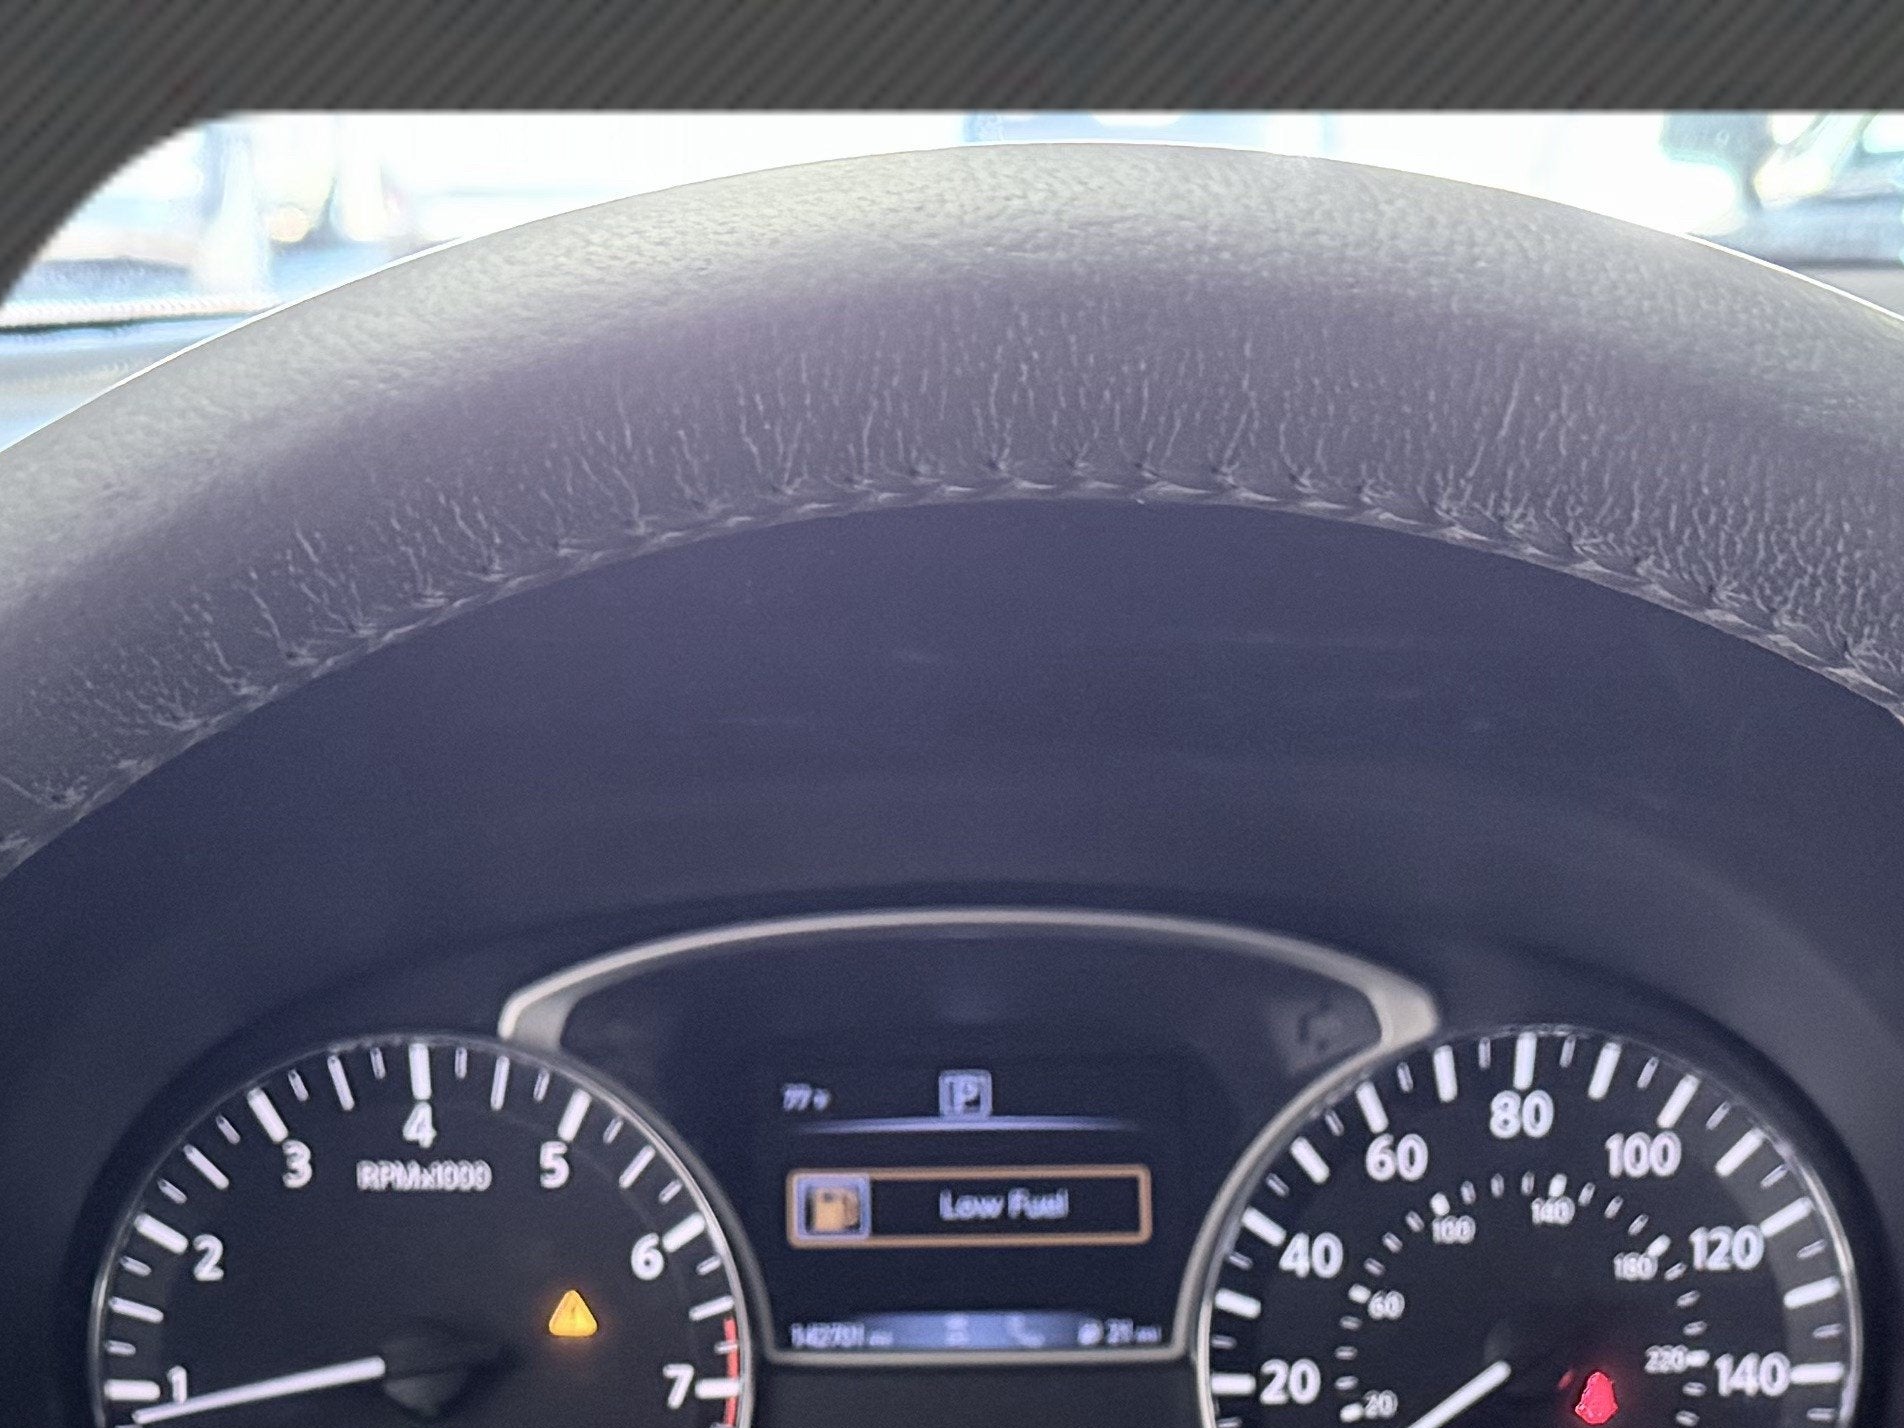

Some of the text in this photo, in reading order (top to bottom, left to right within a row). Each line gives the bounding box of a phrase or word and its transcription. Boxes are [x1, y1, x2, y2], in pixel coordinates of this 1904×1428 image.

[404, 1101, 437, 1149] 4
[1489, 1089, 1555, 1138] 80
[284, 1141, 314, 1189] 3
[539, 1141, 570, 1190] 5
[1364, 1133, 1430, 1182] 60
[1605, 1130, 1683, 1179] 100
[939, 1186, 1070, 1221] Low Fuel
[1530, 1195, 1576, 1227] 140
[1431, 1214, 1477, 1246] 100
[1688, 1225, 1766, 1271] 120
[192, 1237, 225, 1282] 2
[630, 1233, 666, 1281] 6
[1279, 1231, 1344, 1278] 40
[1613, 1252, 1658, 1283] 180
[1368, 1291, 1406, 1321] 60
[1258, 1357, 1321, 1405] 20
[1644, 1345, 1689, 1374] 220
[1714, 1352, 1792, 1398] 140
[167, 1365, 189, 1404] 1
[662, 1363, 695, 1409] 7
[1363, 1390, 1399, 1419] 20
